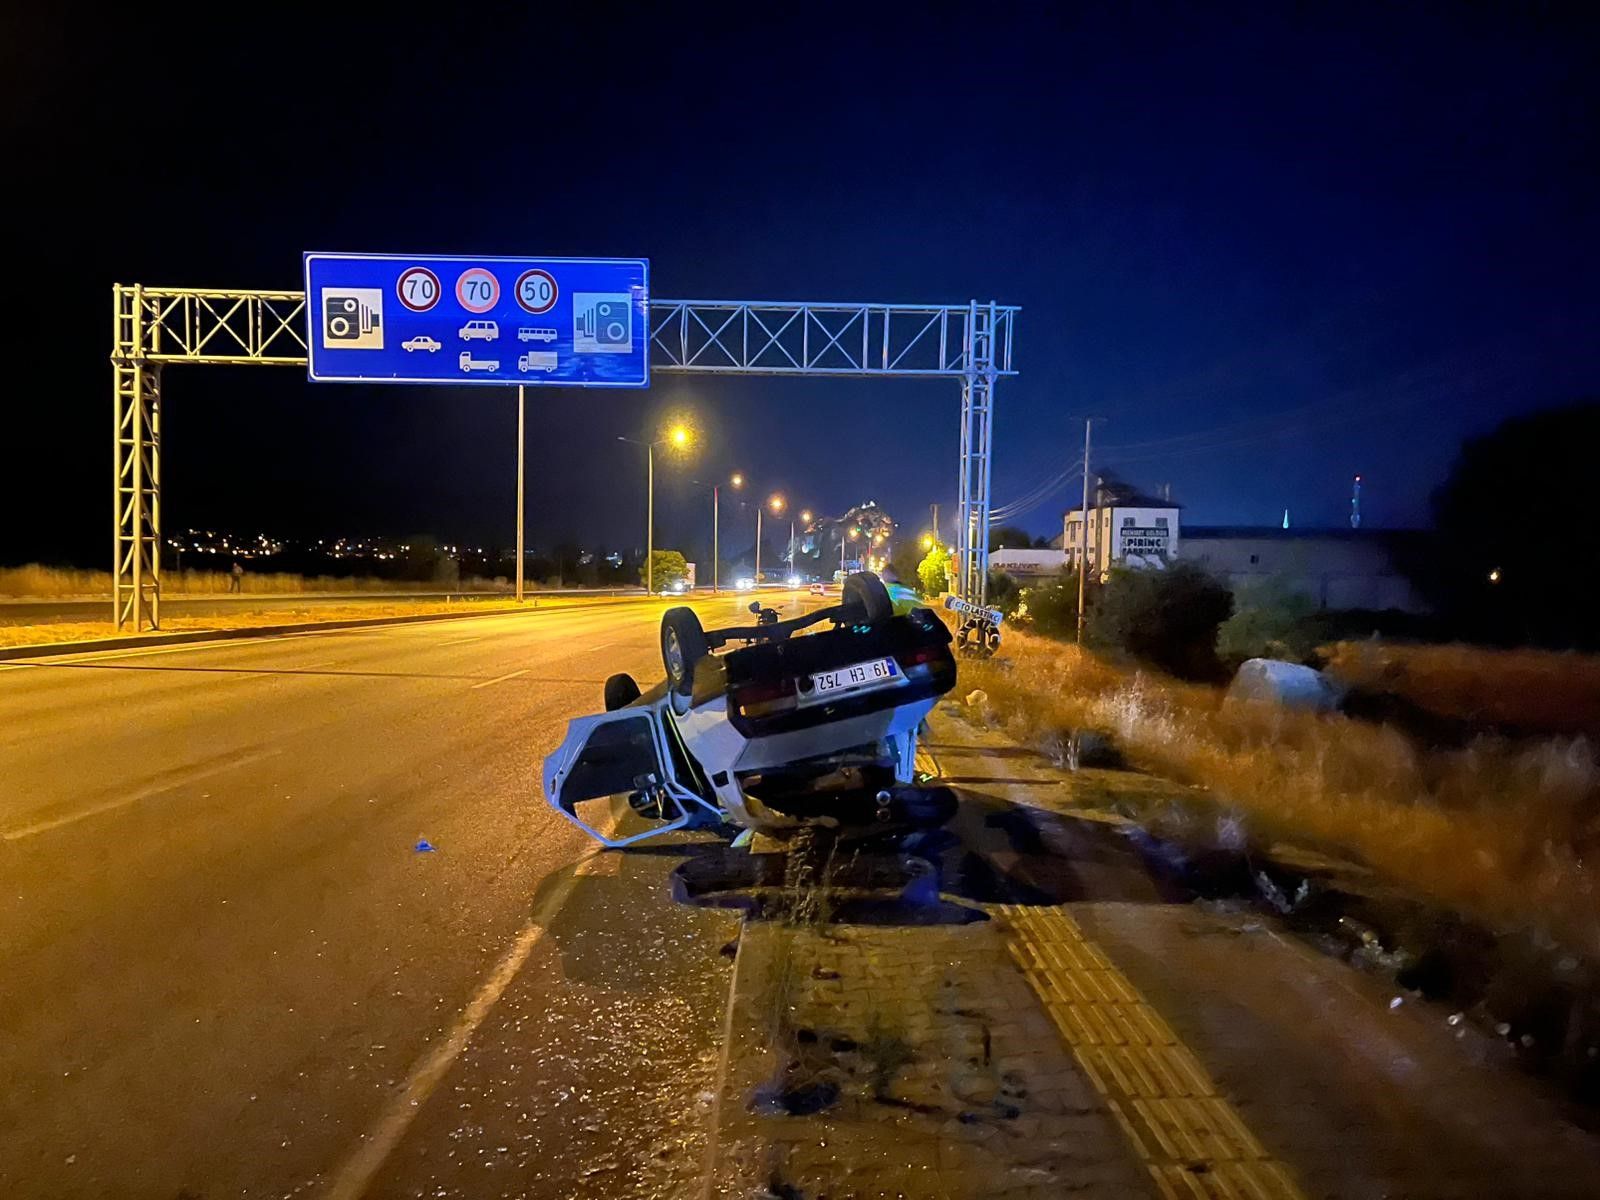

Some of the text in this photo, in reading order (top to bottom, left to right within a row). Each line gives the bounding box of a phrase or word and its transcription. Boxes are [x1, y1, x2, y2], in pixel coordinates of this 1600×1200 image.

[406, 280, 434, 299] 70
[466, 281, 492, 301] 70
[524, 281, 551, 301] 50
[818, 662, 888, 690] 19 EH 752
